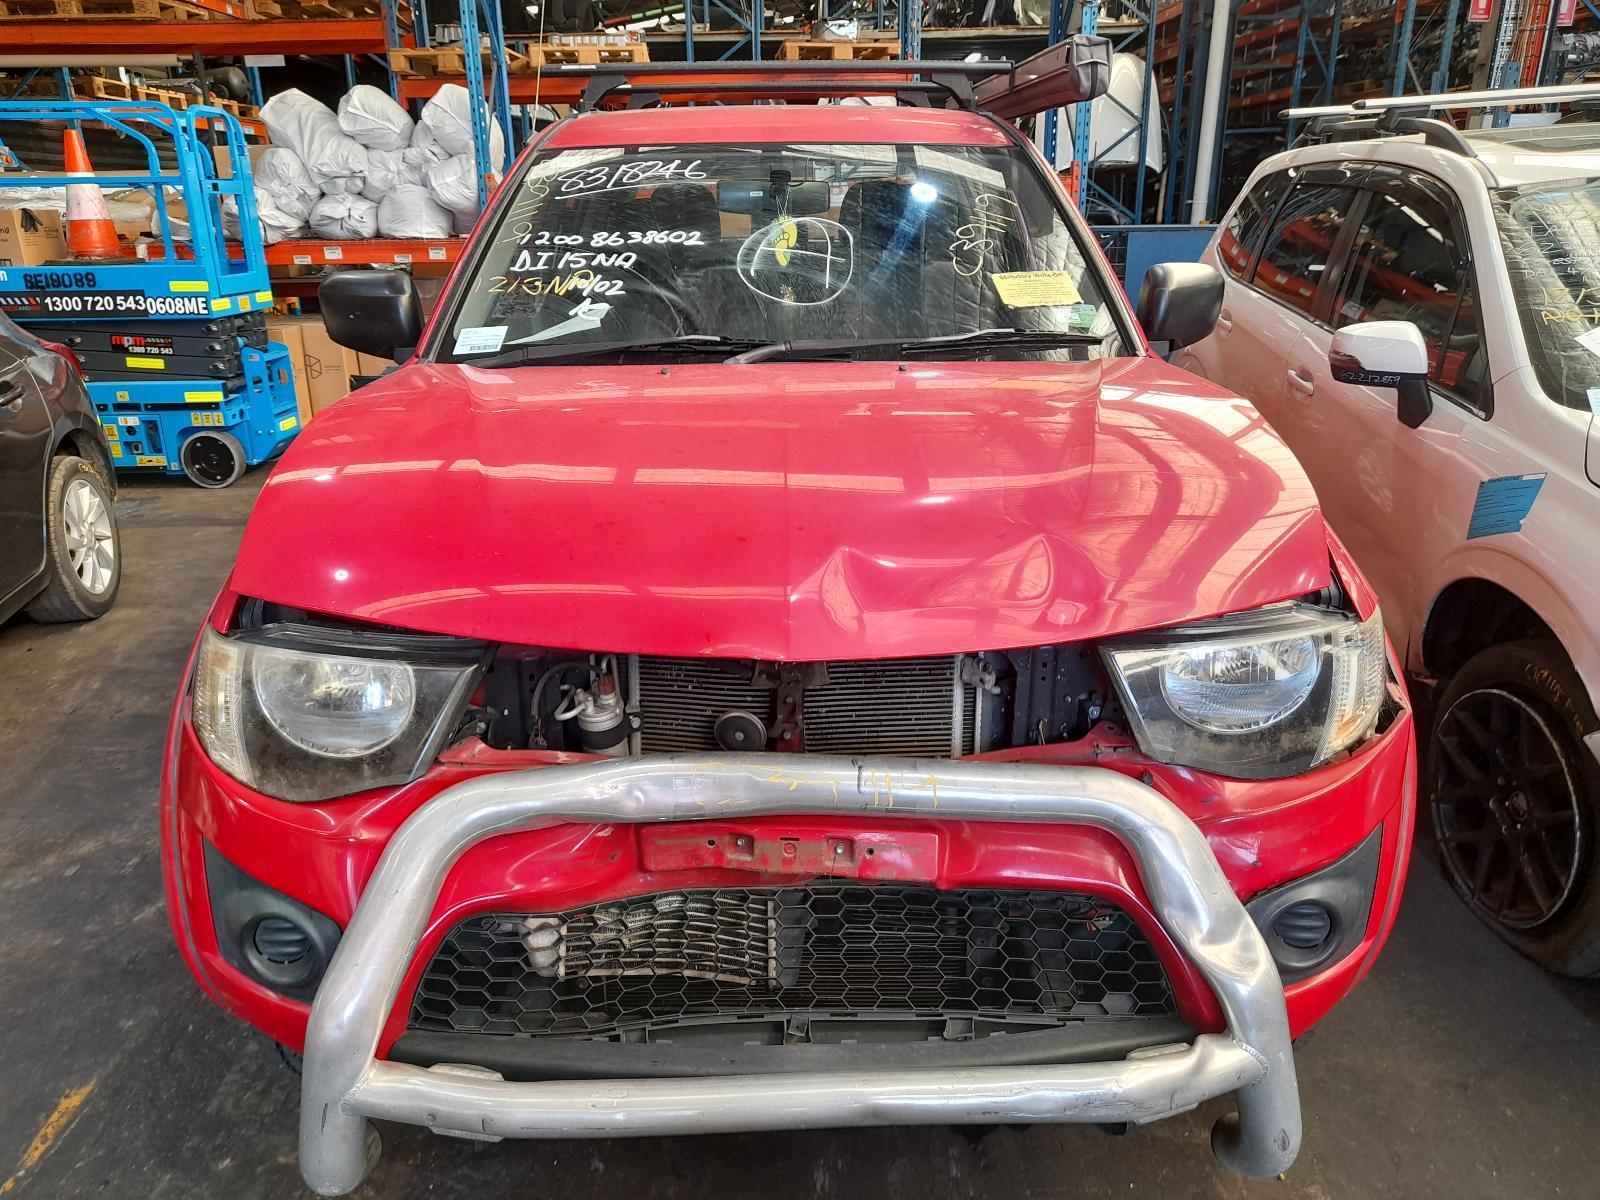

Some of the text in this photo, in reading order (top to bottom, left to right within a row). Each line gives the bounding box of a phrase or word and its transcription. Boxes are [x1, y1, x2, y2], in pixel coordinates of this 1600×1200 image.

[556, 159, 706, 192] 8318246
[45, 296, 208, 315] 1300 720 543 0608ME
[112, 336, 145, 347] mpm
[128, 346, 173, 355] 1300 720 543
